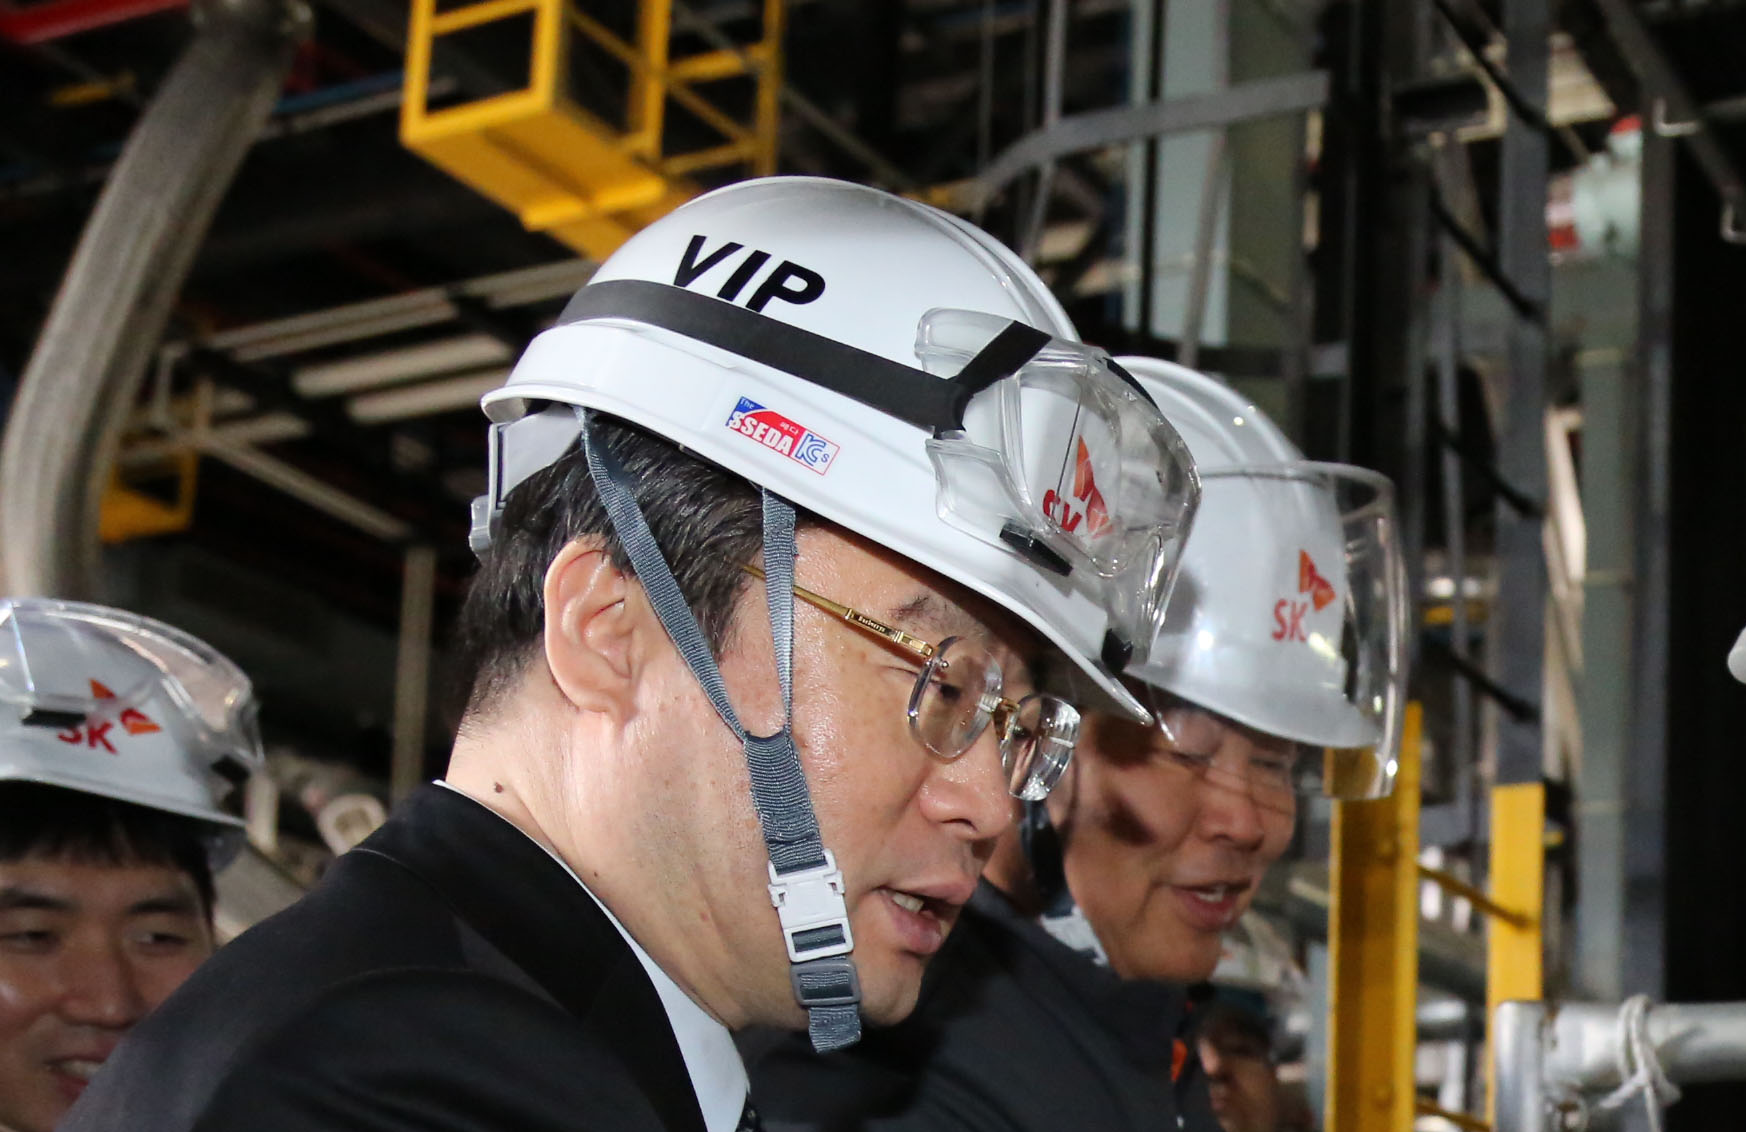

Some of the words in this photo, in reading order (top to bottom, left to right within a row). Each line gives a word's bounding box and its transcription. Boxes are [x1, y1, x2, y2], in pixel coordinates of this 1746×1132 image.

[673, 234, 826, 313] VIP
[741, 398, 755, 410] The
[1272, 599, 1308, 642] SK
